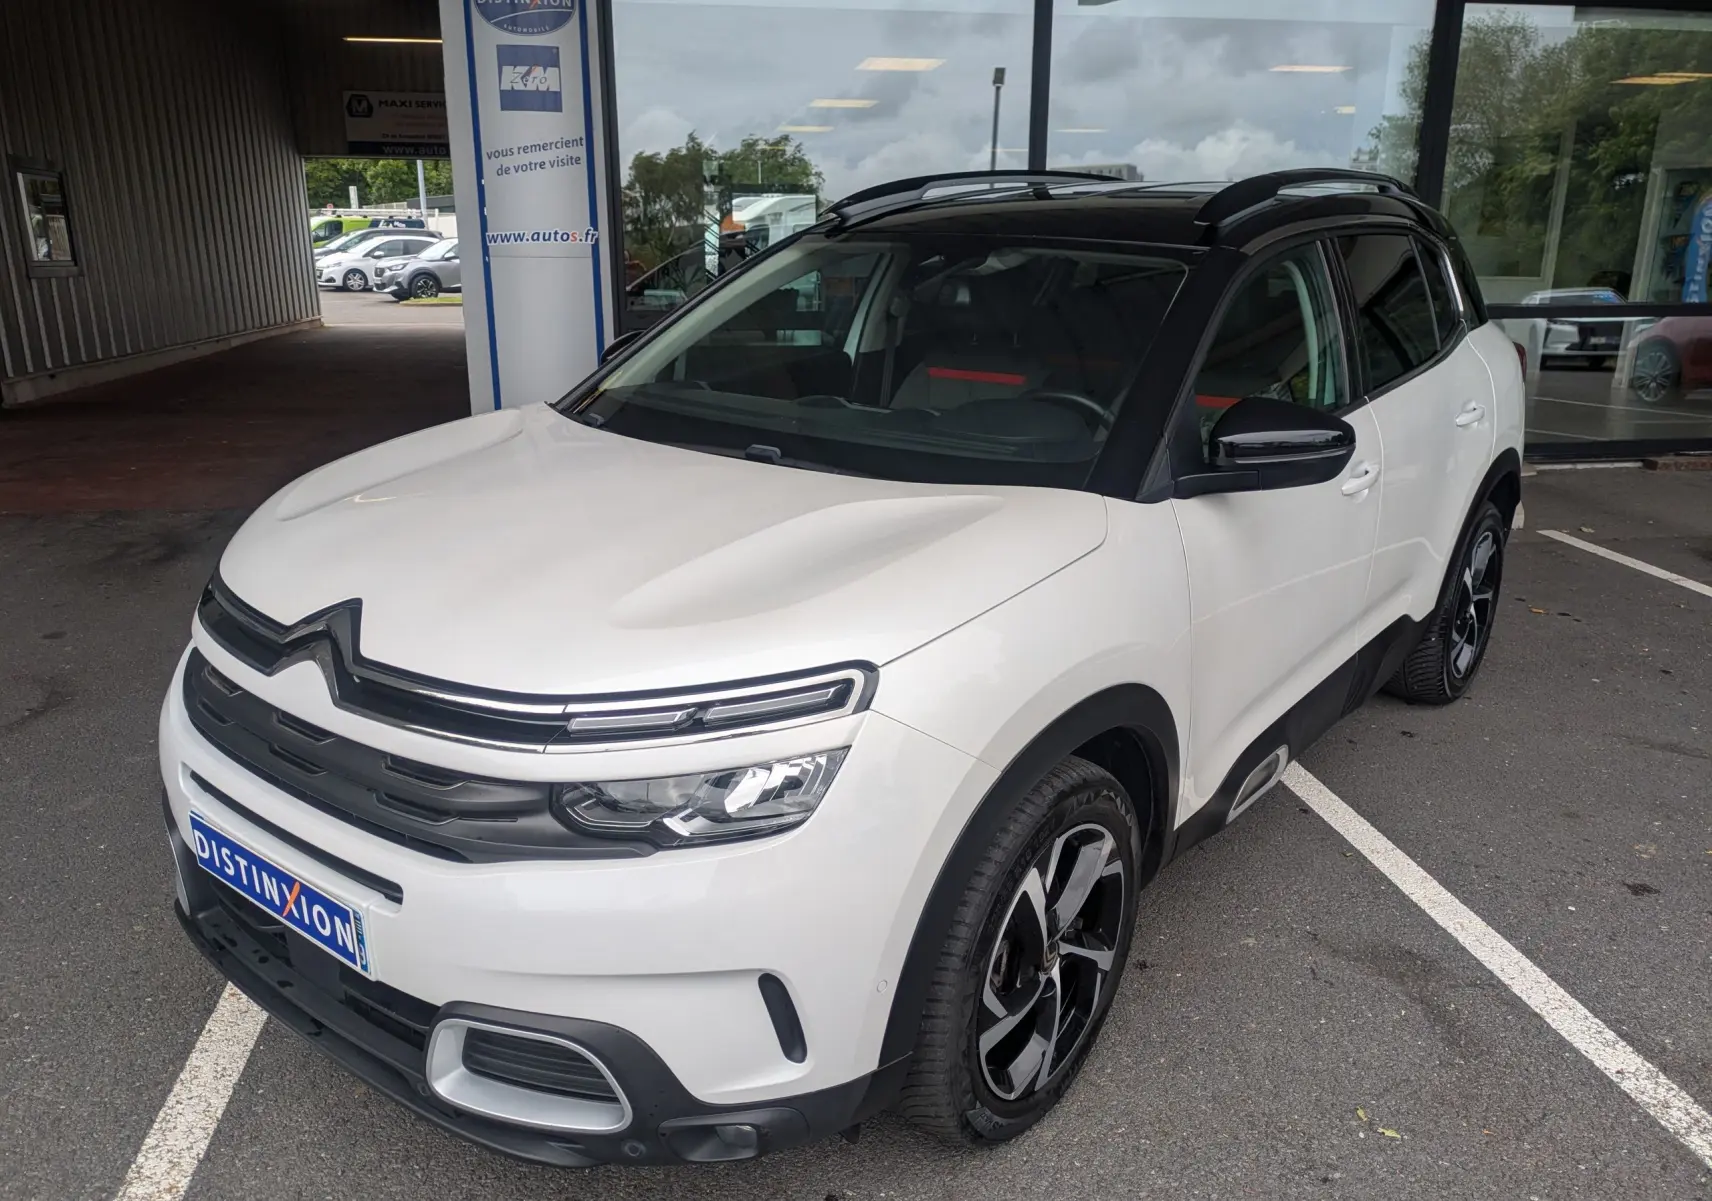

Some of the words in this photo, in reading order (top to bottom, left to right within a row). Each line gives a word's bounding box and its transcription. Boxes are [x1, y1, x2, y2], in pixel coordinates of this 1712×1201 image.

[379, 99, 412, 108] MAXI
[486, 147, 514, 160] vous
[517, 136, 584, 154] remercient
[496, 164, 511, 176] de
[513, 161, 546, 173] votre
[549, 154, 582, 168] visite
[486, 228, 598, 244] www.autos.fr
[193, 829, 354, 953] DISTINXION
